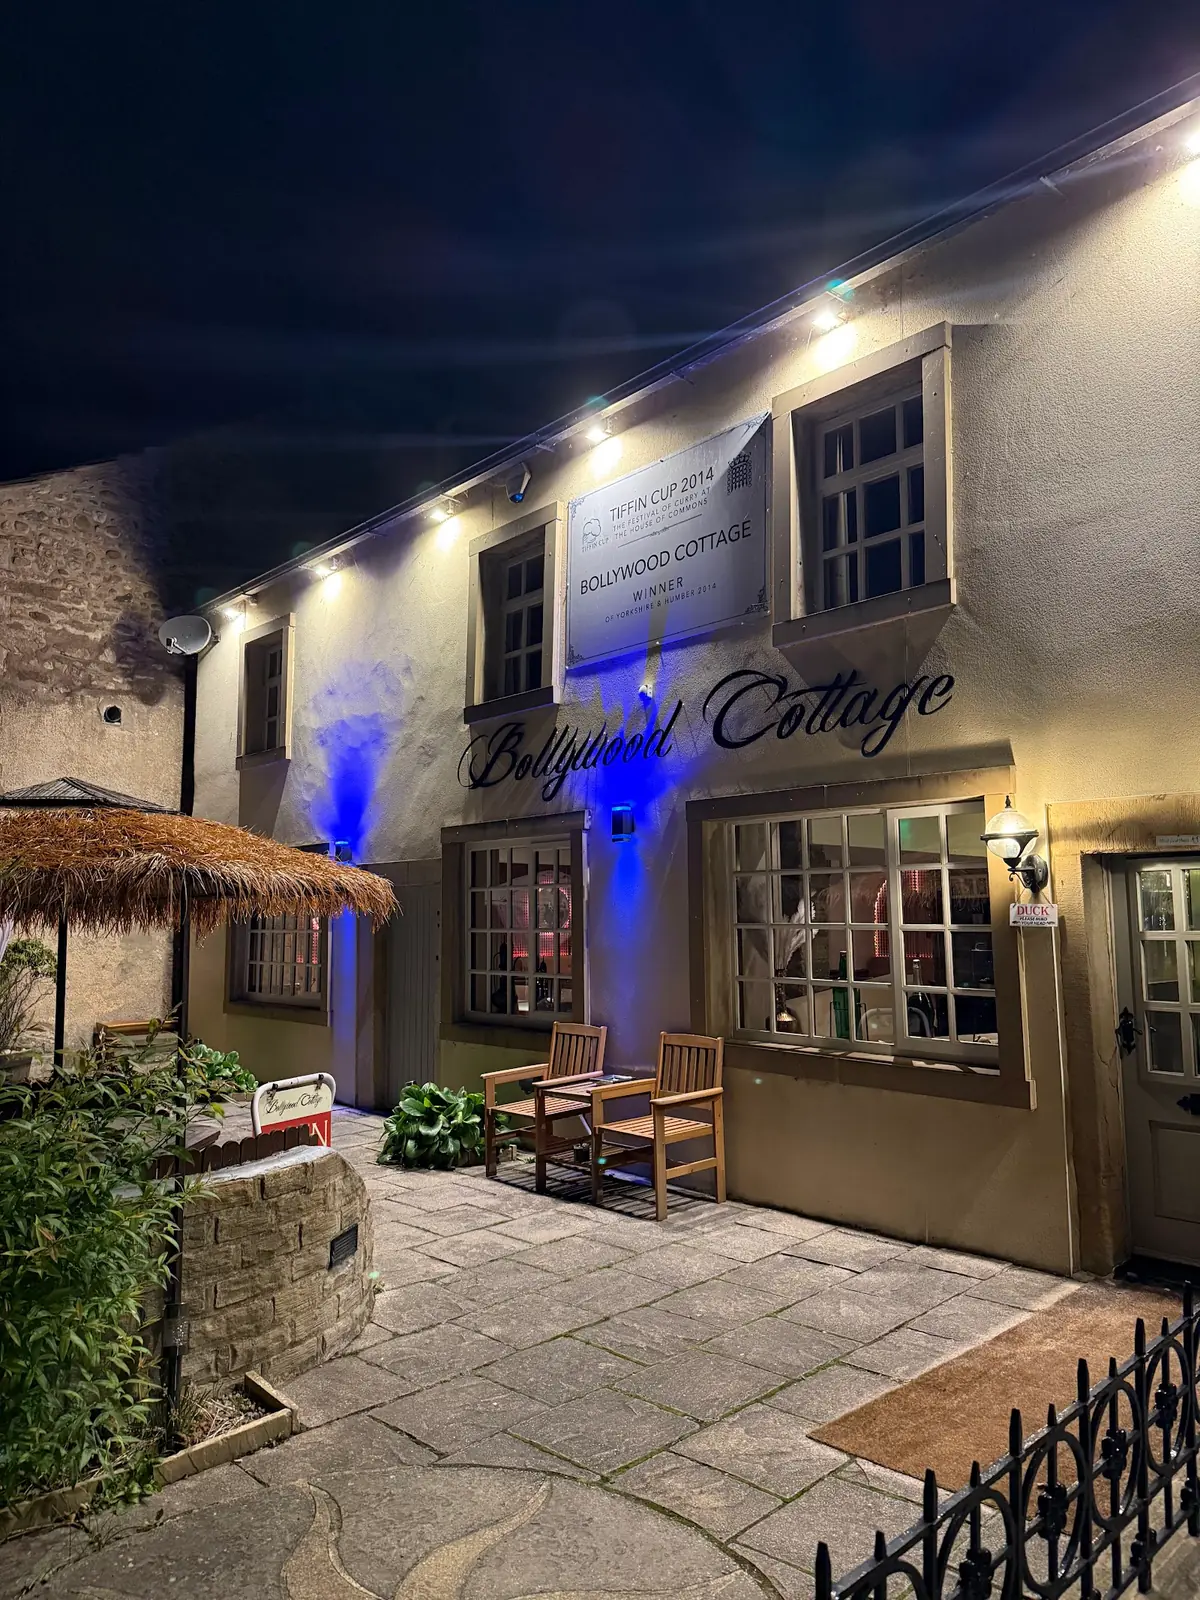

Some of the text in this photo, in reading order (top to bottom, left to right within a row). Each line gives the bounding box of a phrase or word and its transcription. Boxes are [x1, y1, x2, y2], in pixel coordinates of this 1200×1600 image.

[610, 466, 714, 521] TIFFIN CUP 2014
[613, 486, 711, 532] THE FESTIVAL OF CURRY AT
[615, 497, 708, 540] THE HOUSE OF COMMONS
[580, 520, 752, 595] BOLLYWOOD COTTAGE
[605, 615, 614, 623] OF
[616, 601, 654, 619] YORKSHIRE
[664, 589, 695, 604] HUMBER
[698, 583, 717, 594] 2014
[633, 576, 683, 602] WINNER
[457, 669, 955, 801] Bollywood Cottage
[1017, 905, 1049, 916] DUCK
